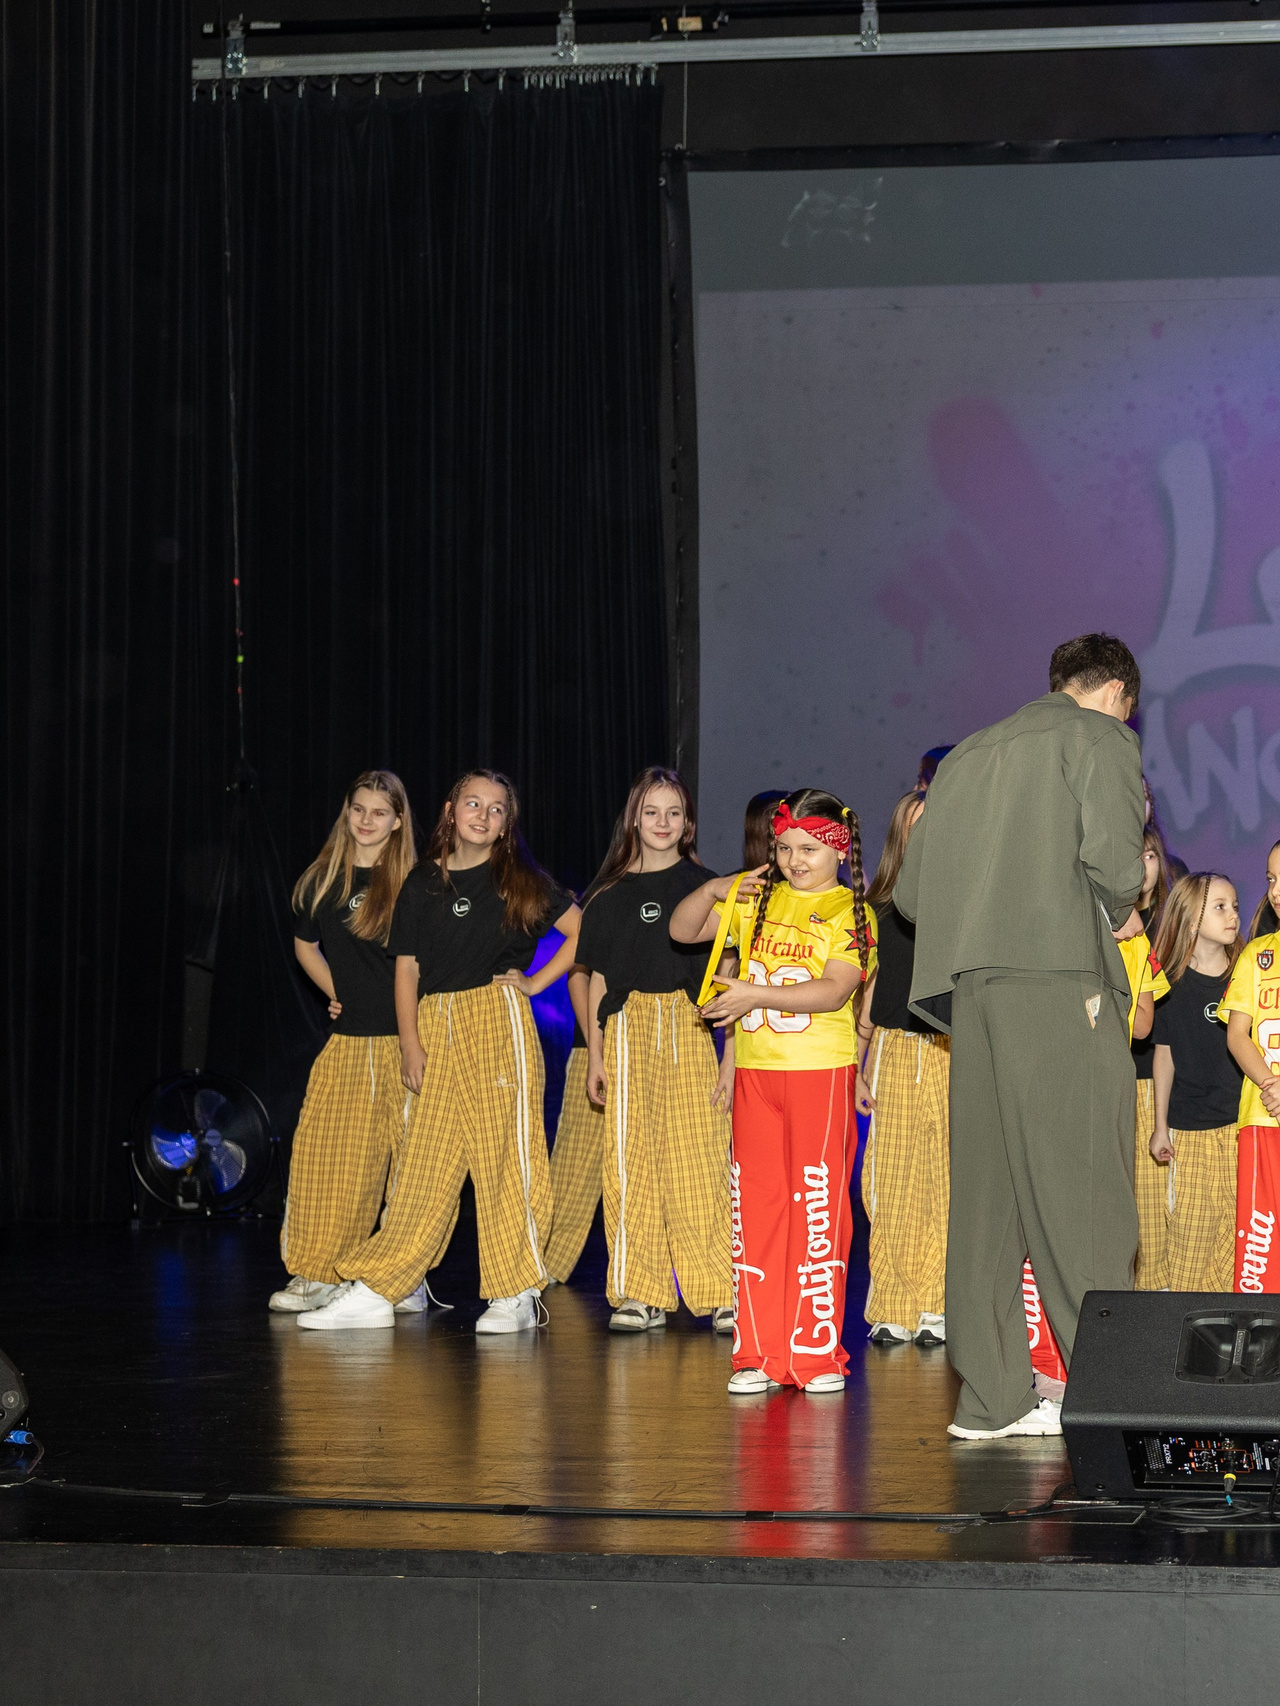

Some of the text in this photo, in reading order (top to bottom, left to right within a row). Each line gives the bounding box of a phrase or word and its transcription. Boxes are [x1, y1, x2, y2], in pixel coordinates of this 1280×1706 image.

[750, 934, 814, 963] hicago
[789, 1161, 846, 1355] California
[1238, 1209, 1276, 1294] ornia
